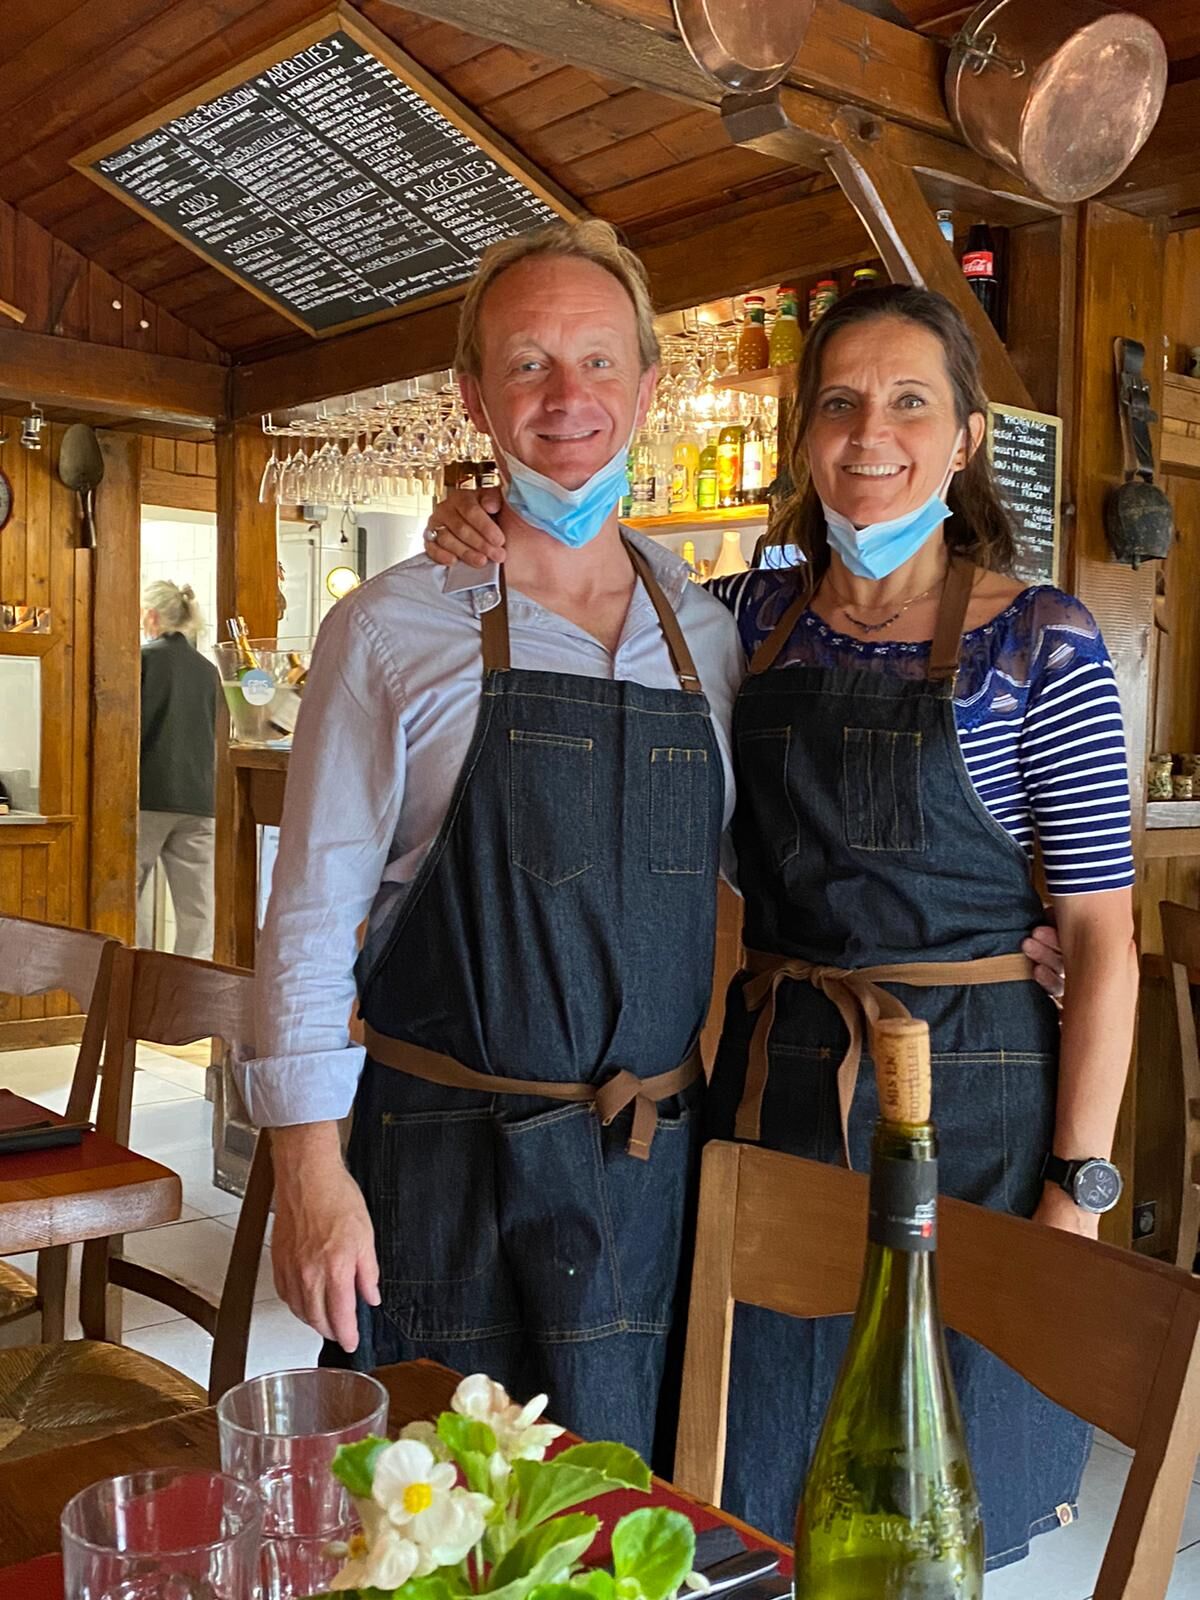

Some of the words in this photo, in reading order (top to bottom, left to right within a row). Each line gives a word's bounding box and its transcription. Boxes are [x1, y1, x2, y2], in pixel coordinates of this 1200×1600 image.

[197, 88, 253, 118] PRESSION
[276, 93, 291, 103] LA
[414, 161, 491, 198] DIGESTIFS
